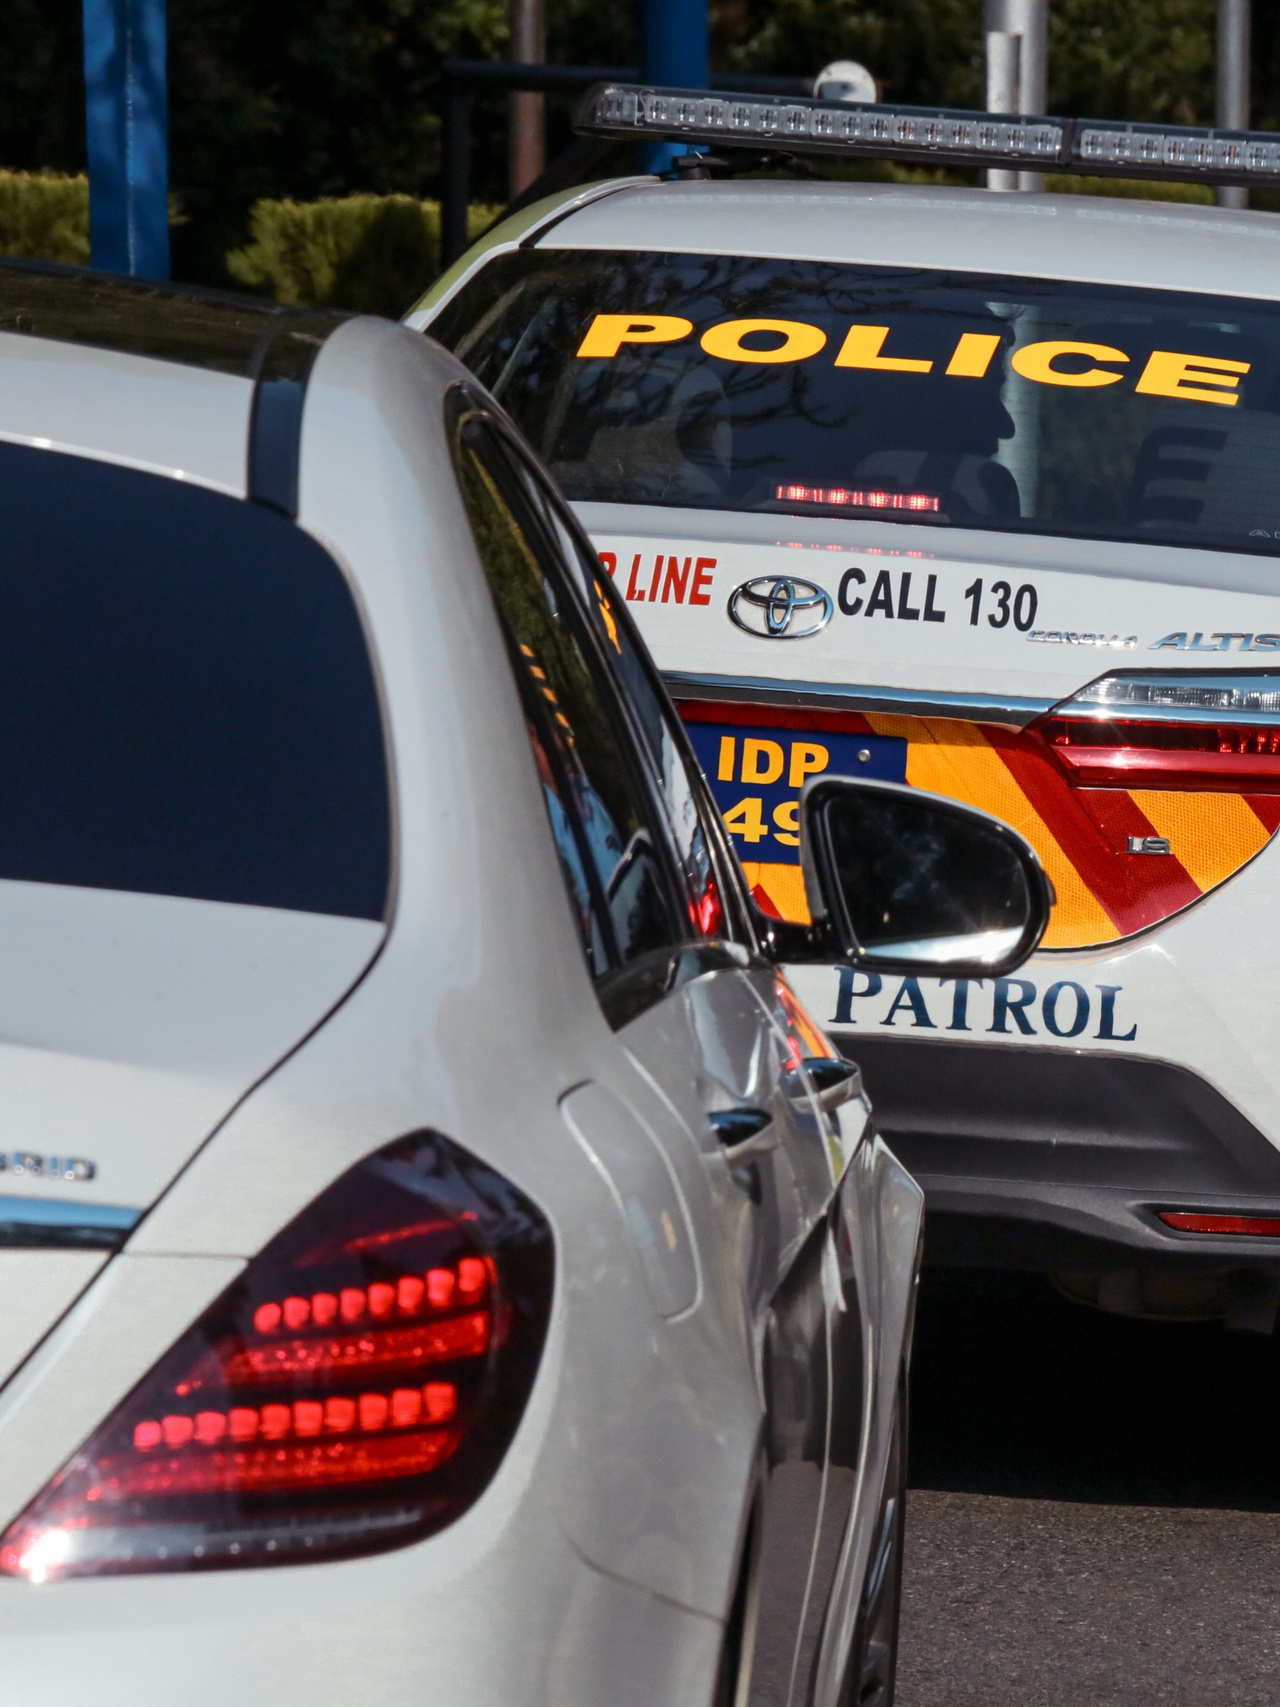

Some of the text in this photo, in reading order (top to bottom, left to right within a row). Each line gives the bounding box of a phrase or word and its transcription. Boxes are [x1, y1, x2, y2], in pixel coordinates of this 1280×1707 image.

[576, 314, 1252, 406] POLICE
[626, 554, 717, 606] LINE
[838, 567, 946, 623] CALL
[964, 577, 1038, 632] 130
[1026, 630, 1138, 648] COROLLA
[717, 736, 830, 788] IDP
[828, 966, 1138, 1042] PATROL
[0, 1152, 97, 1181] RID
